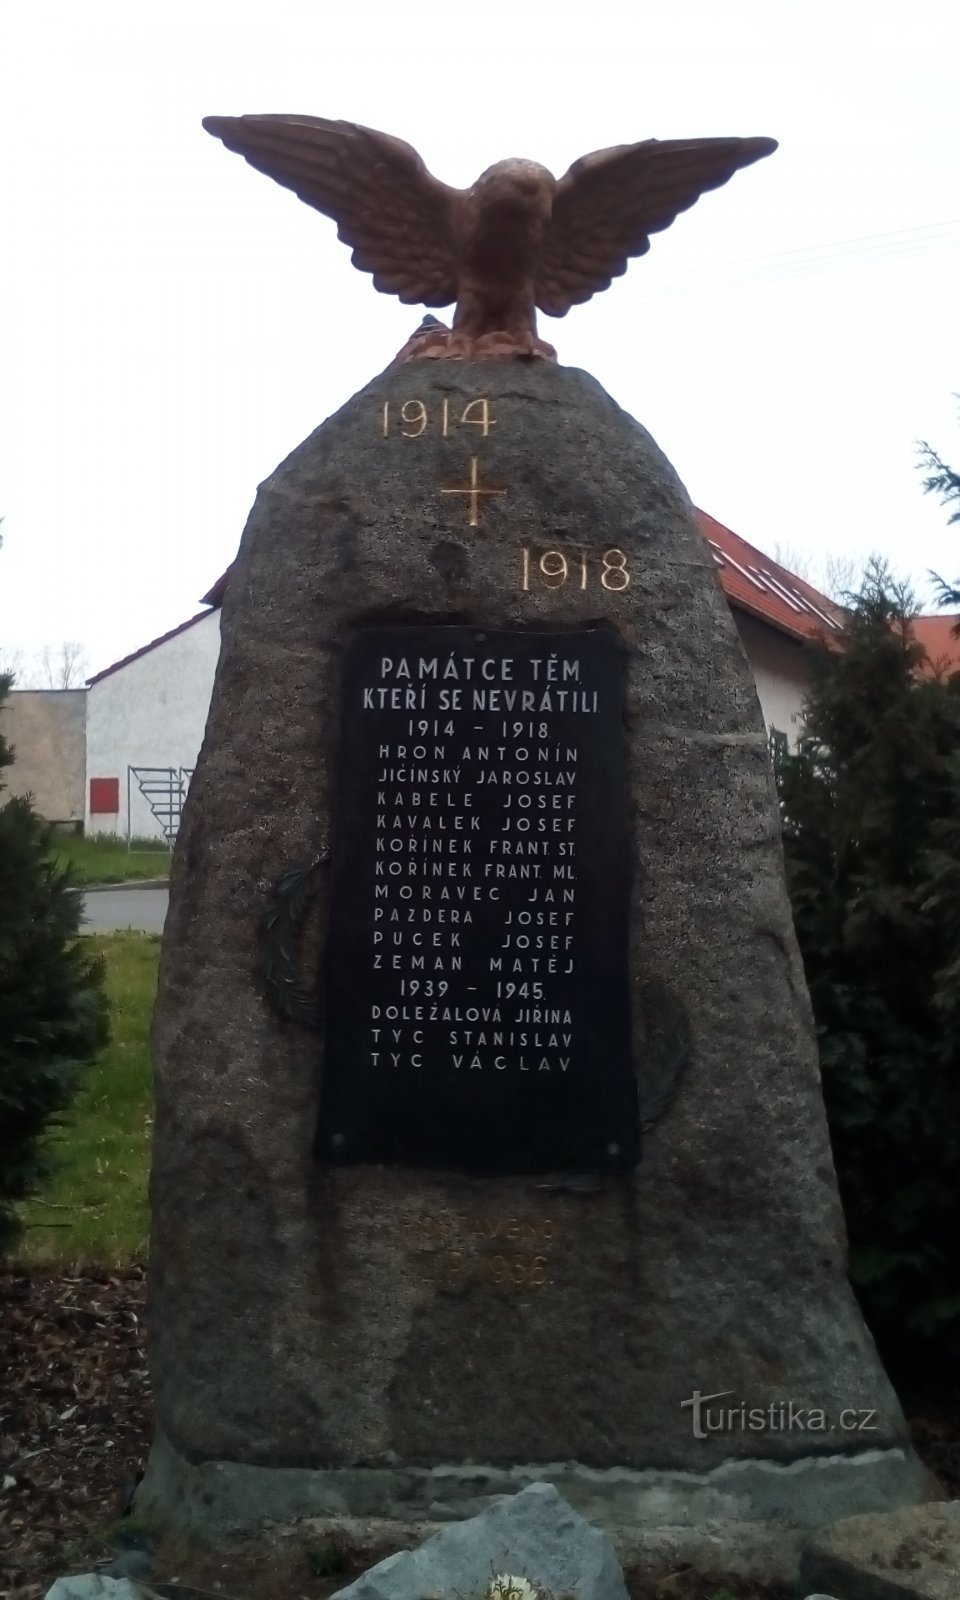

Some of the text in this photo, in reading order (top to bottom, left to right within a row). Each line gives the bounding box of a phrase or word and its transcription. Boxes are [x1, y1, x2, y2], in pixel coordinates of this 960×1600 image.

[383, 398, 497, 437] 1914
[523, 548, 631, 591] 1918
[381, 651, 514, 681] PAMÁTCE
[363, 683, 427, 710] KTEŘÍ
[439, 689, 463, 711] SE
[408, 719, 455, 737] 1914
[379, 742, 578, 763] HRON ANTONÍN
[378, 763, 577, 786] JIČÍNSKÝ JAROSLAV
[377, 791, 577, 810] KABELE JOSEF
[376, 814, 576, 832] KAVALEK JOSEF
[376, 833, 472, 854] KOŘÍNEK
[375, 857, 472, 877] KOŘÍNEK
[375, 885, 575, 903] MORAVEC JAN
[374, 907, 575, 926] PAZDERA JOSEF
[373, 931, 574, 950] PUCEK JOSEF
[373, 953, 574, 974] ZEMAN MATĚJ
[400, 979, 449, 998] 1939
[371, 1002, 573, 1025] DOLEŽALOVÁ JIŘINA
[371, 1029, 573, 1048] TYC STANISLAV
[370, 1050, 571, 1072] TYC VÁCLAV
